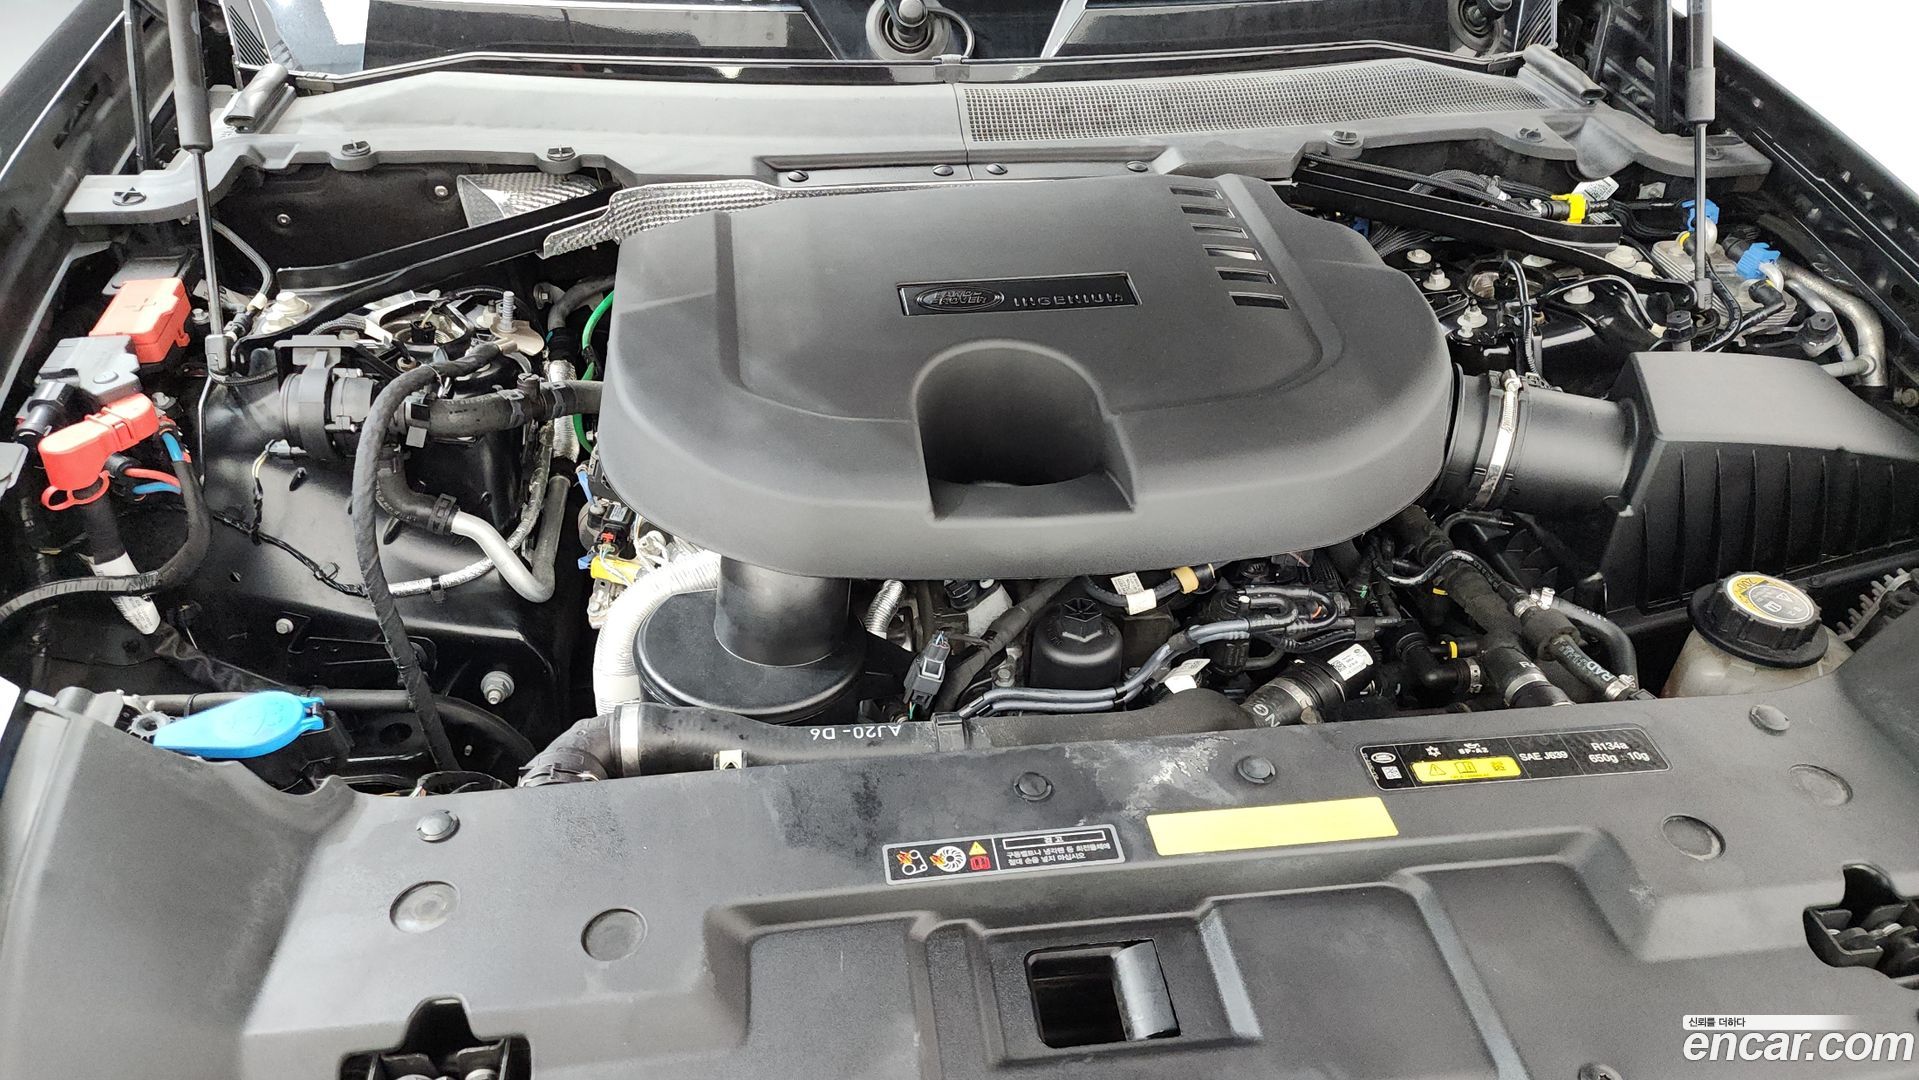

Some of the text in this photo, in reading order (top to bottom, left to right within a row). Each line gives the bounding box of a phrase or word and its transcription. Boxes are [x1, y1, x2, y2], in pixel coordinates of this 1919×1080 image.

[1013, 292, 1124, 307] INGENIUM
[1590, 741, 1629, 751] R134a
[1518, 750, 1569, 762] SAE J639
[1588, 753, 1619, 764] 650g
[1627, 751, 1650, 762] 10g
